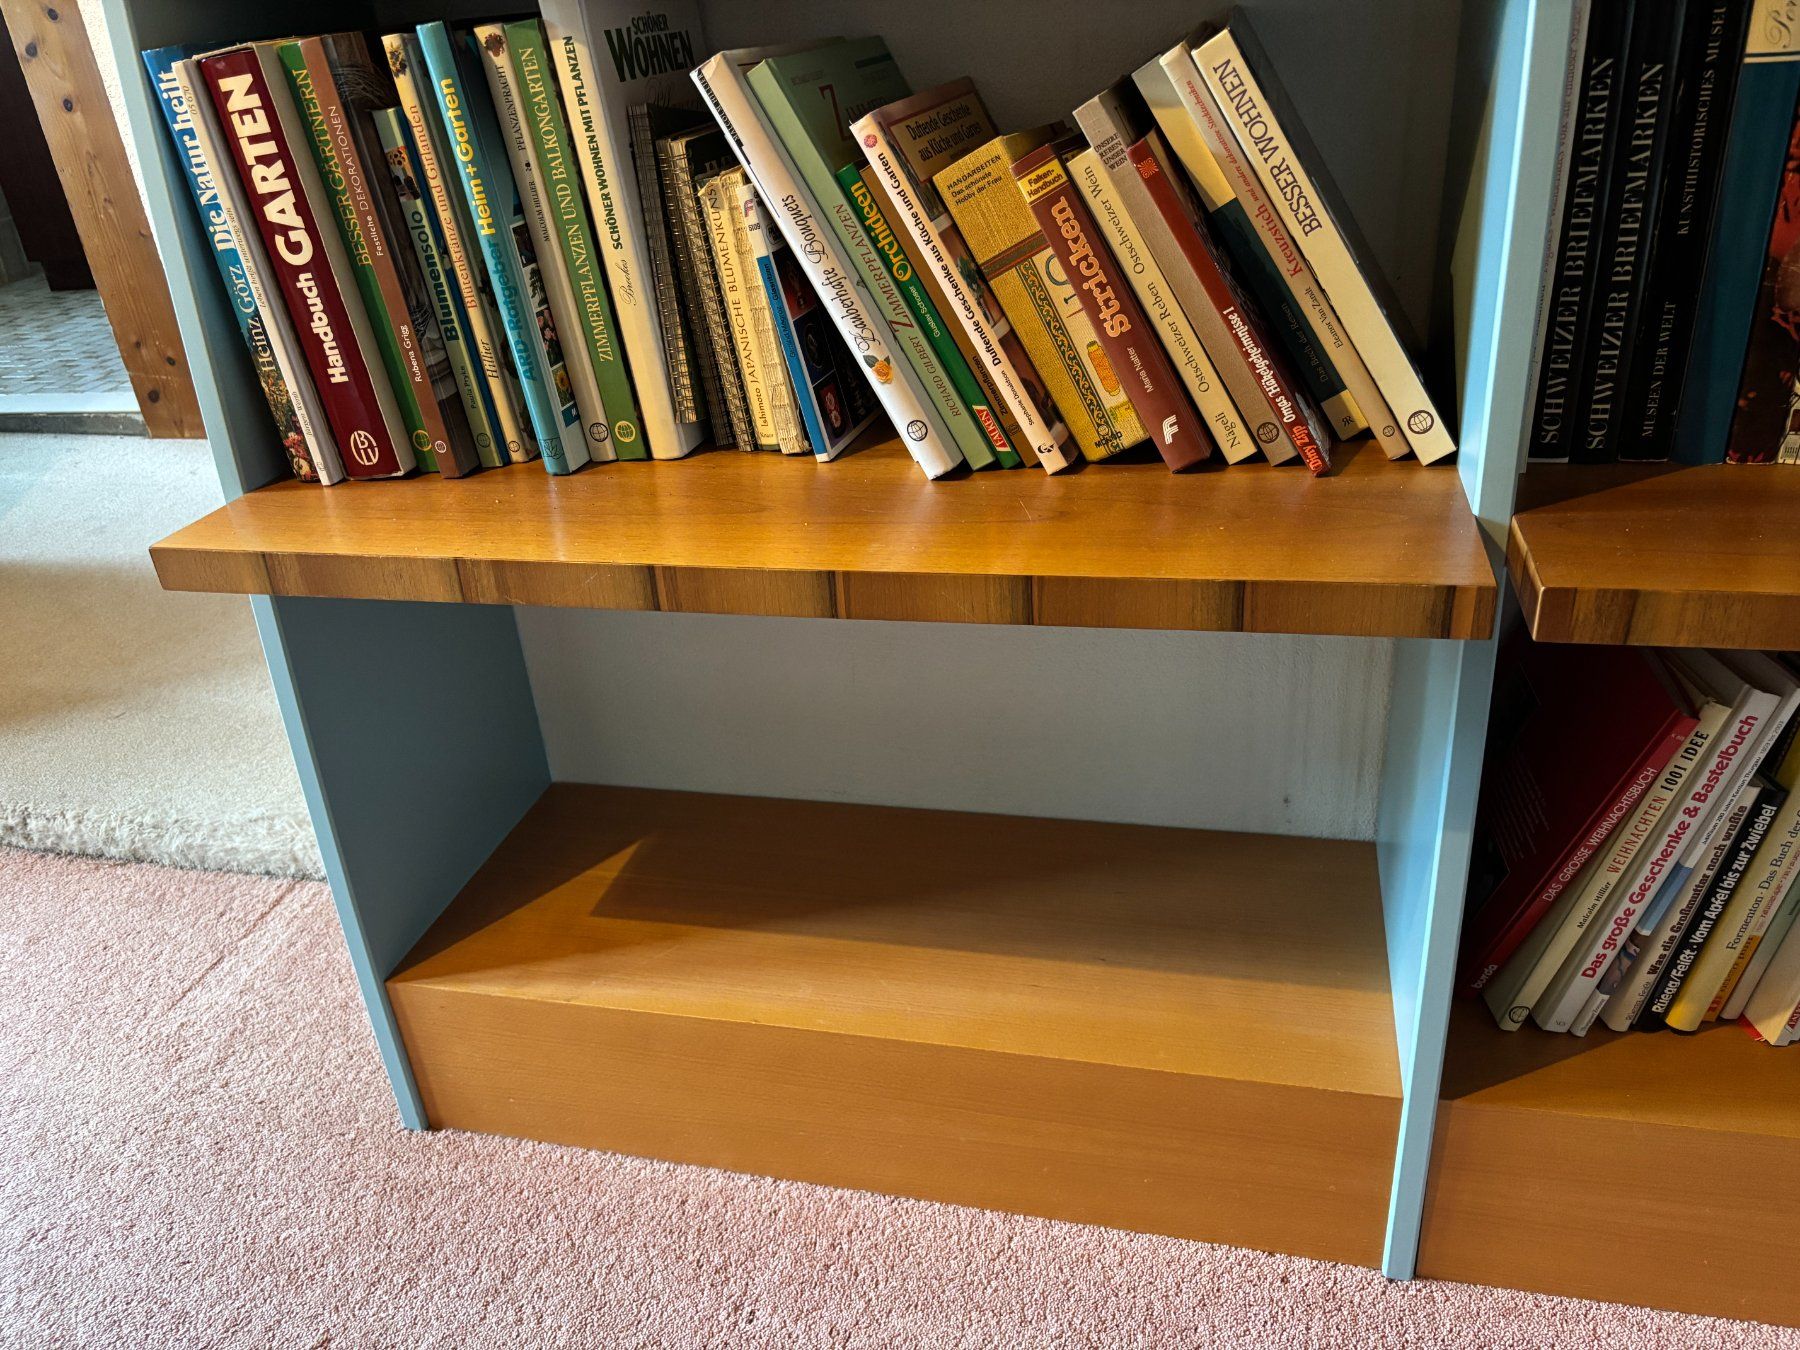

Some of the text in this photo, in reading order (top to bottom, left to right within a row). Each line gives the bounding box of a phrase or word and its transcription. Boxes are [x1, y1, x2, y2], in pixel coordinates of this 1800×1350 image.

[604, 26, 696, 83] WOHNEN
[632, 10, 669, 35] SCHÖNER
[496, 62, 529, 149] PFLANZENPRACHT
[562, 35, 622, 249] SCHÖNER WOHNEN MIT PFLANZEN
[1212, 58, 1322, 236] BESSER WOHNEN
[161, 71, 232, 253] Die Natur heilt
[292, 68, 373, 265] BESSER GÄRTNERN
[327, 105, 383, 255] Festliche DEKORATIONEN
[443, 77, 498, 236] Heim + Garten
[947, 154, 1001, 191] HANDARBEITEN
[1027, 169, 1055, 187] Falken-
[1027, 173, 1064, 198] Handbuch
[1109, 156, 1128, 171] WEIN
[1186, 79, 1303, 277] Kreuzstich und andere dekorative Sticktechniken
[1677, 69, 1713, 234] KUNSTHISTORISCHES
[228, 73, 348, 382] Handbuch GARTEN
[405, 104, 475, 306] Blütenkränze und Girlanden
[519, 47, 613, 361] ZIMMERPFLANZEN UND BALKONGARTEN
[528, 180, 549, 241] MALCOLM HILLIER
[781, 193, 828, 264] Bouquets
[851, 181, 911, 281] Orchideen
[956, 191, 976, 206] Hobby
[1084, 165, 1144, 274] Ostschweizer Wein
[415, 209, 462, 339] Blumensolo
[836, 204, 914, 328] ZIMMERPFLANZEN
[877, 152, 1001, 366] Duftende Geschenke aus Küche und Garten
[1051, 196, 1130, 337] Stricken
[1542, 287, 1580, 442] SCHWEIZER
[1563, 58, 1612, 275] BRIEFMARKEN
[1589, 64, 1662, 448] SCHWEIZER BRIEFMARKEN
[236, 264, 276, 373] Heinz Görz
[400, 324, 422, 381] Rubena Grigg
[480, 240, 532, 384] ARD-Ratgeber
[731, 298, 759, 383] JAPANISCHE
[822, 267, 881, 353] Zauberhafte
[908, 285, 940, 337] Gustav Schoser
[1147, 281, 1209, 392] Ostschweizer Reben
[1302, 286, 1343, 348] Eleanor Van Zandt
[460, 365, 476, 409] Paula Pryke
[477, 337, 497, 381] Hillier
[907, 336, 961, 416] RICHARD GILBERT
[972, 355, 1008, 415] Zimmerpflanzen
[1126, 347, 1153, 392] Maria Natter
[1228, 313, 1295, 422] Omas Häkelgeheimnisse
[1641, 301, 1675, 436] MUSEEN DER WELT
[755, 387, 768, 426] Ishimoto
[980, 410, 1003, 445] FALKEN
[1017, 399, 1034, 425] Stephanie
[1214, 411, 1240, 448] Nägeli
[1542, 767, 1657, 901] DAS GROSSE WEIHNACHTSBUCH
[1606, 795, 1666, 872] WEIHNACHTEN
[1660, 764, 1686, 791] 1001
[1680, 730, 1708, 761] IDEE
[1740, 803, 1776, 850] Zwiebel
[1580, 952, 1607, 978] Das
[1601, 907, 1635, 951] große
[1628, 820, 1690, 904] Geschenke
[1682, 802, 1700, 818] &
[1691, 715, 1758, 803] Bastelbuch
[1719, 870, 1740, 888] bis
[1725, 896, 1763, 950] Formenton
[1758, 869, 1777, 890] Das
[1769, 841, 1793, 867] Buch
[1787, 820, 1800, 838] der
[1732, 850, 1750, 870] zur
[1576, 881, 1610, 928] Malcolm Hillier
[1646, 805, 1747, 975] Was die Großmutter noch wußte
[1689, 919, 1712, 943] Vom
[1704, 888, 1730, 918] Apfel
[1471, 964, 1498, 988] burda
